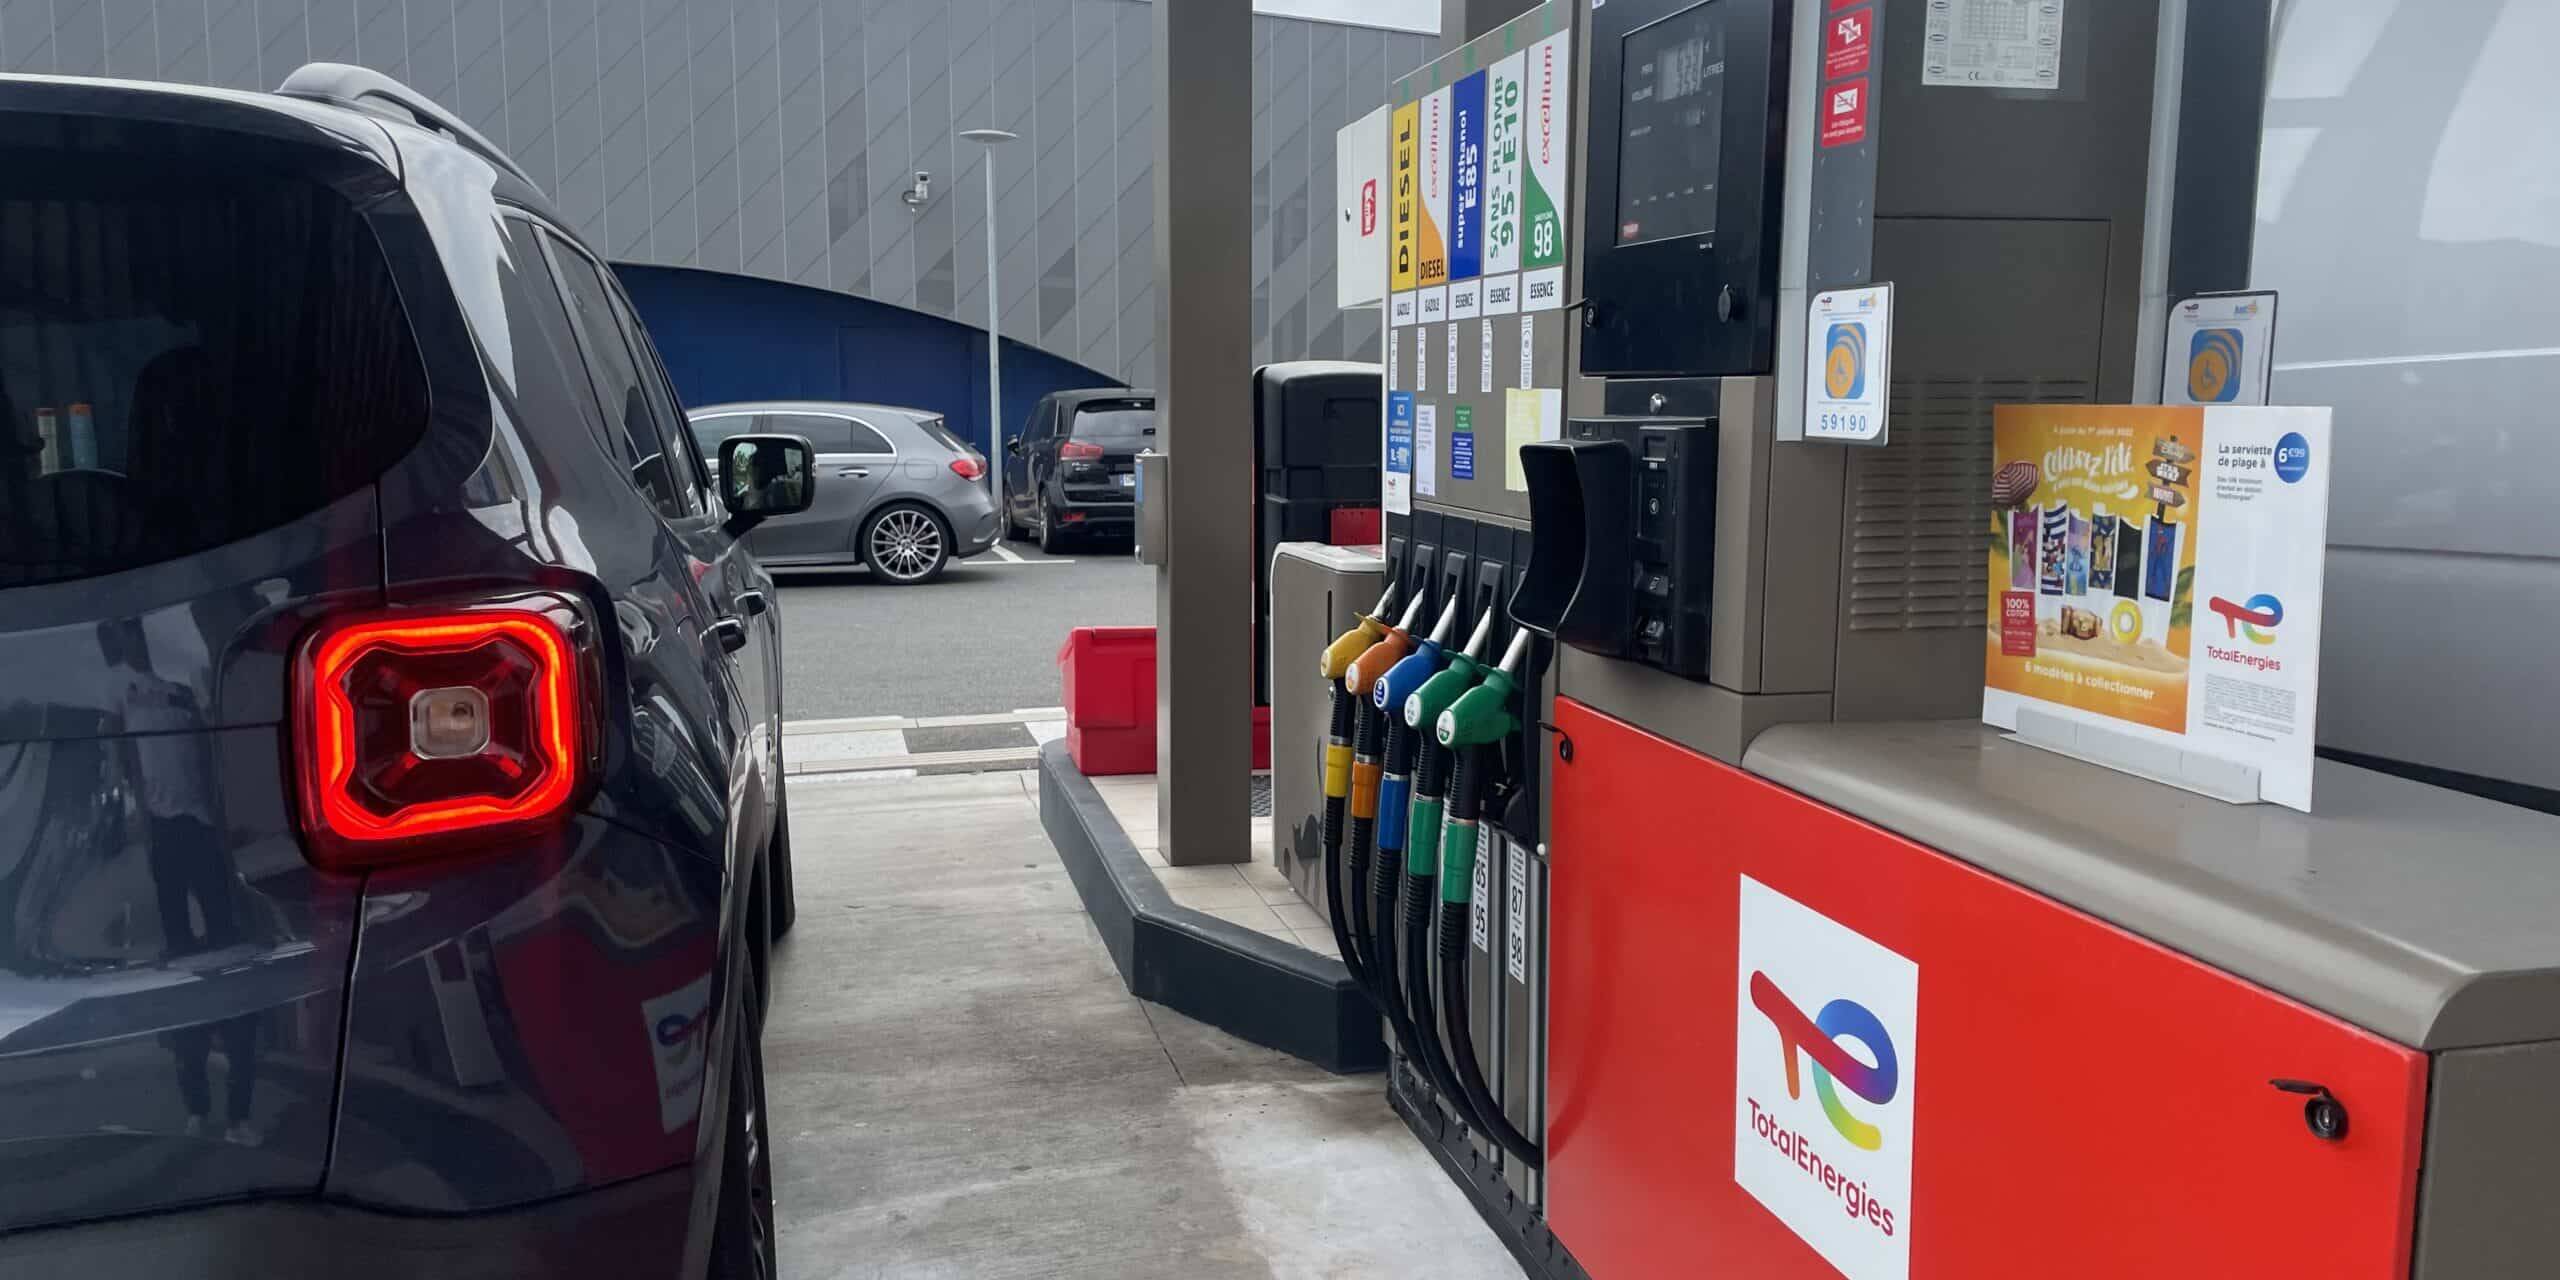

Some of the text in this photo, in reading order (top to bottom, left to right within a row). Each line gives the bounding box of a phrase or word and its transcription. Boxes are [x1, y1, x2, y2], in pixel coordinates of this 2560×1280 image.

[1465, 143, 1478, 208] E85
[1490, 76, 1503, 258] SANS PLOMB
[1399, 119, 1410, 274] DIESEL
[1458, 194, 1466, 248] super
[1534, 220, 1553, 258] 98
[1420, 258, 1445, 280] DIESEL
[1490, 287, 1511, 303] ESSENCE
[1530, 281, 1554, 298] ESSENCE
[1820, 413, 1867, 432] 59190
[2218, 442, 2273, 456] La serviette
[2218, 456, 2229, 466] de
[2231, 457, 2258, 469] plage
[2006, 598, 2030, 609] 100%
[2206, 645, 2281, 671] TotalEnergies
[1511, 885, 1523, 916] 87
[1475, 903, 1486, 933] 95
[1511, 932, 1522, 965] 98
[1747, 1097, 1894, 1237] TotalEnergies
